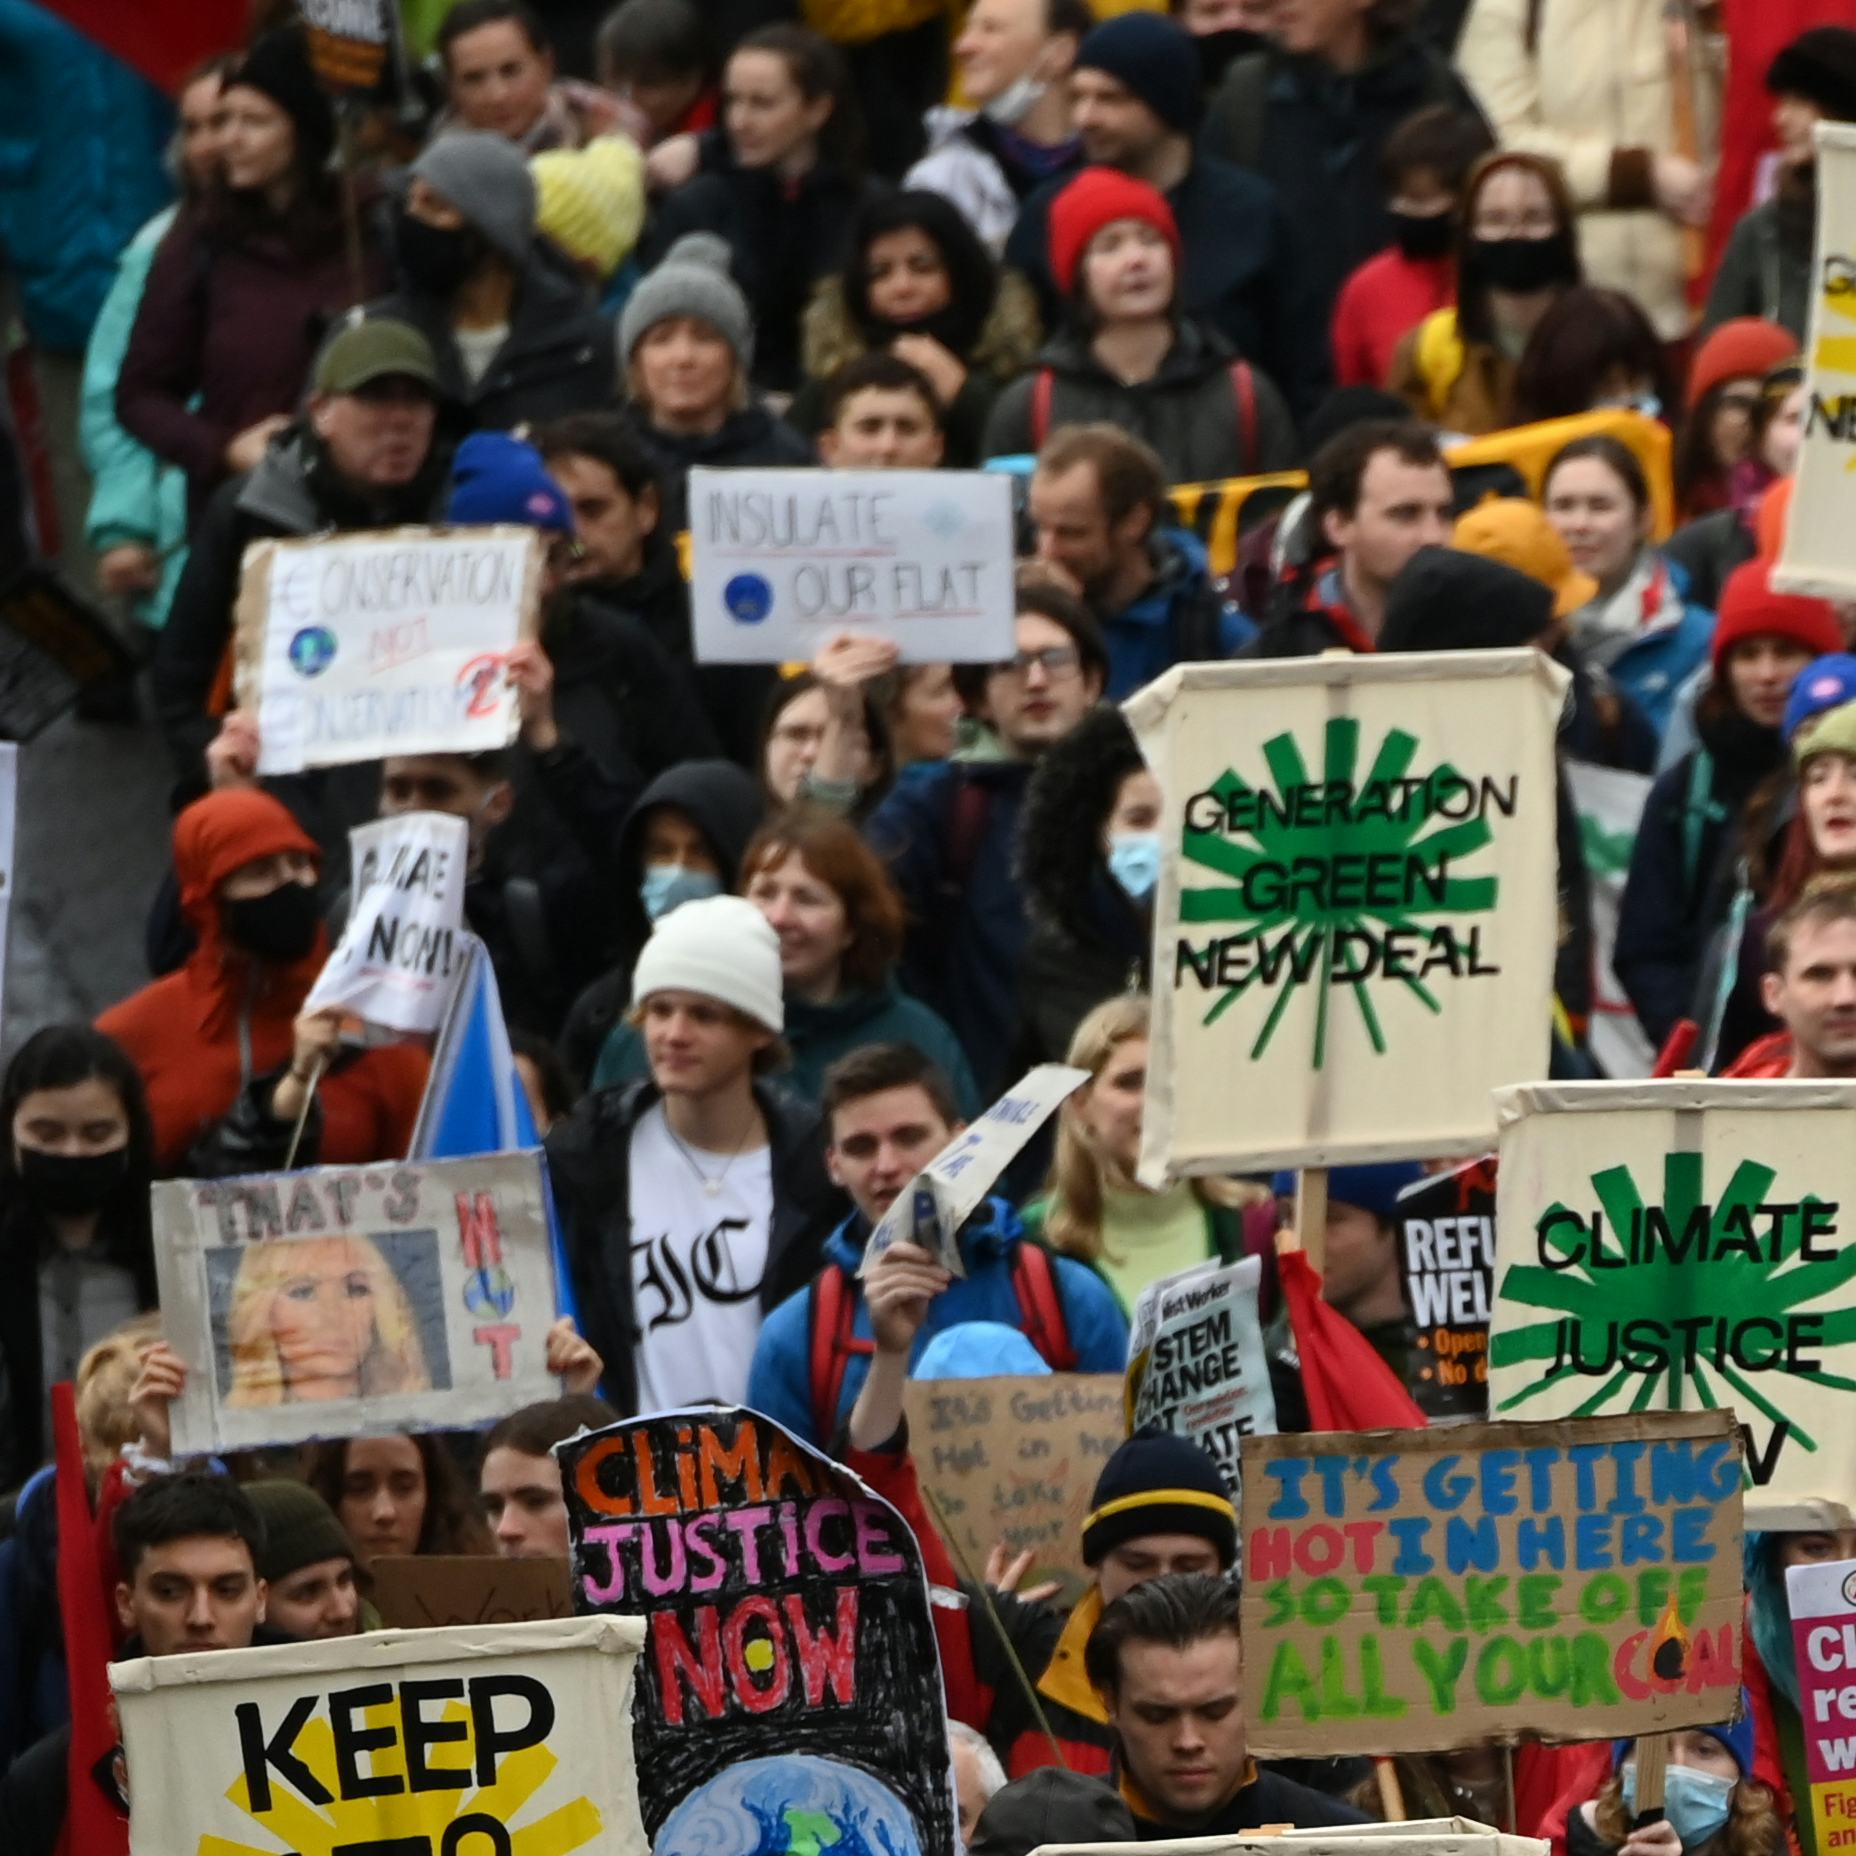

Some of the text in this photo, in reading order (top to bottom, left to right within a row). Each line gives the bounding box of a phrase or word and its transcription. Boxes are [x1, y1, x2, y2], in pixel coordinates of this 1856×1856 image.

[706, 490, 897, 550] INSULATE
[790, 560, 988, 620] OUR FLAT
[369, 617, 430, 661] NOT
[1184, 774, 1519, 837] GENERATION
[1241, 849, 1448, 915] GREEN
[1172, 921, 1500, 990] NEW DEAL
[198, 1172, 420, 1242] THAT'S
[1537, 1202, 1840, 1272] CLIMATE
[1438, 1359, 1467, 1385] No
[1553, 1316, 1826, 1380] JUSTICE
[1265, 1438, 1742, 1522] IT'S GETTING
[1250, 1508, 1718, 1581] HOT IN HERE
[1263, 1566, 1711, 1635] SO TAKE OFF
[652, 1586, 859, 1725] NOW
[1261, 1635, 1405, 1723] ALL
[1412, 1631, 1620, 1715] YOUR
[235, 1674, 555, 1812] KEEP
